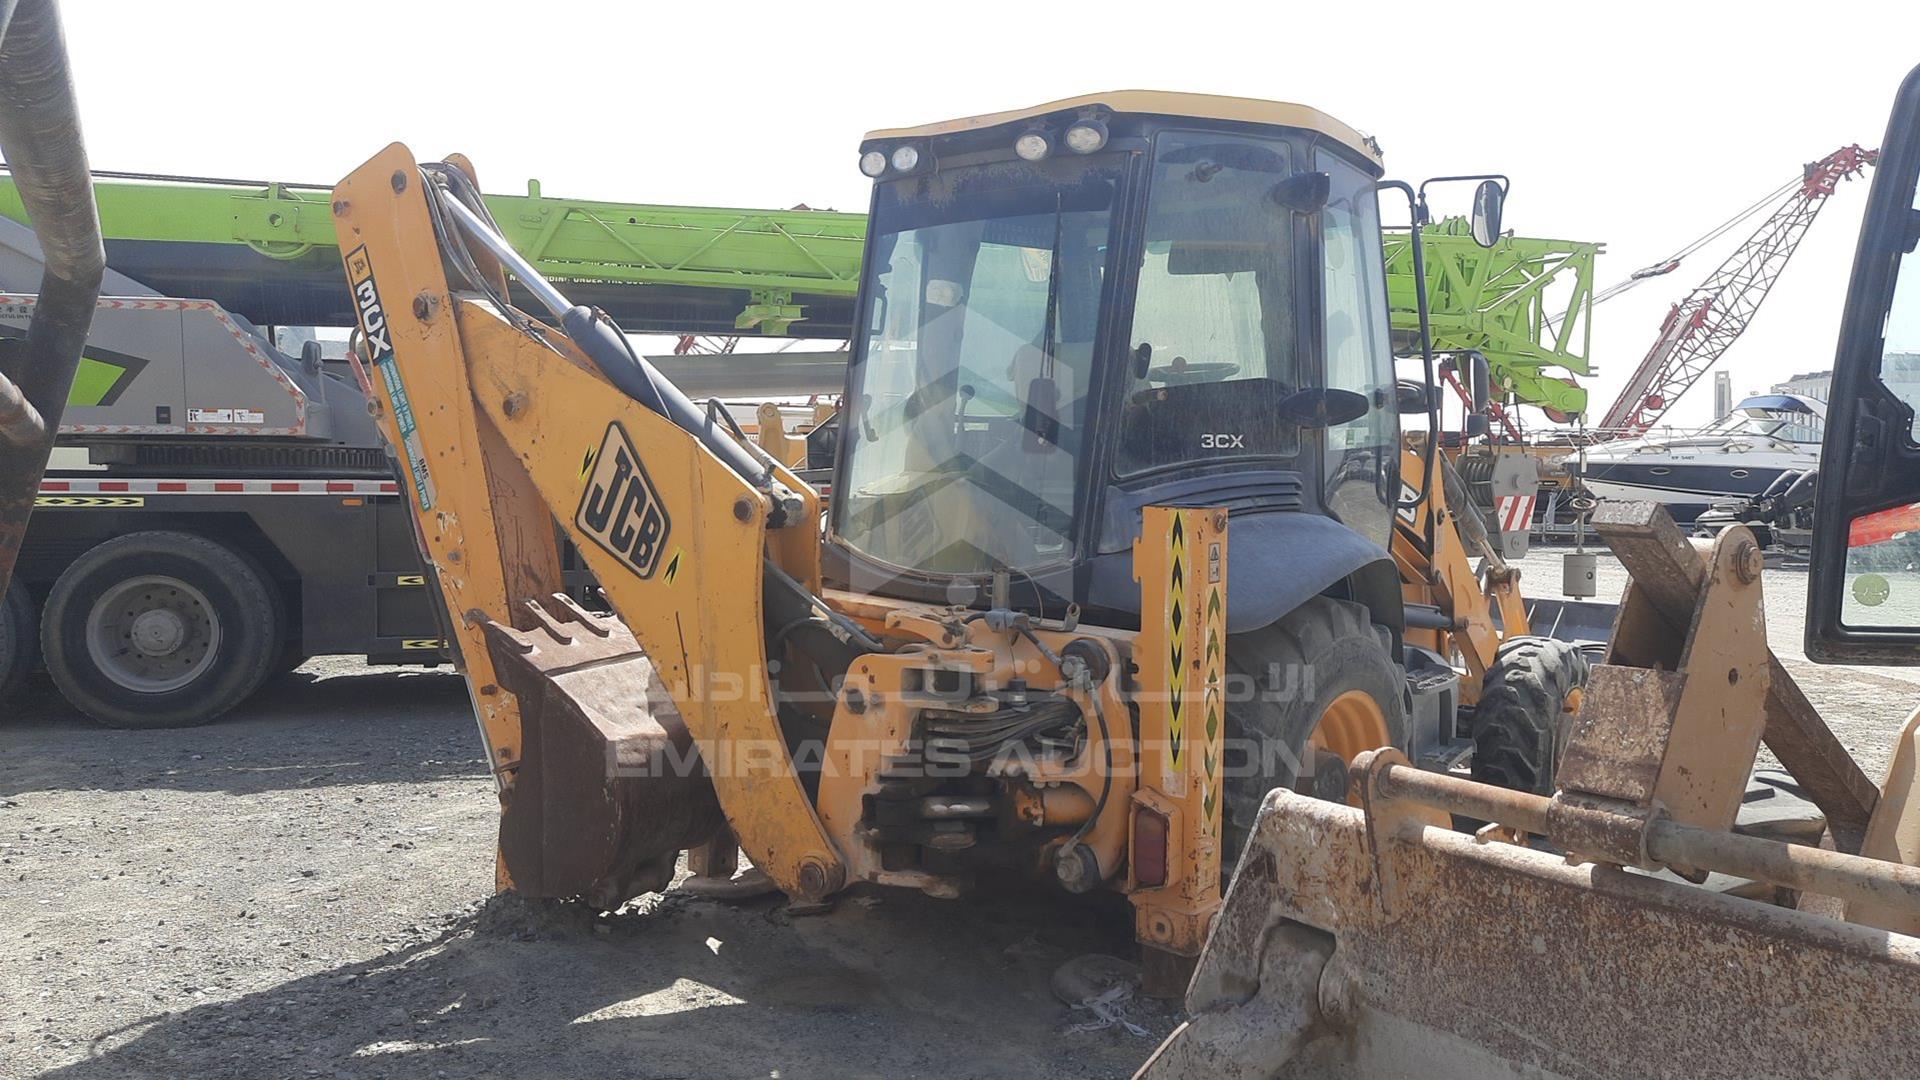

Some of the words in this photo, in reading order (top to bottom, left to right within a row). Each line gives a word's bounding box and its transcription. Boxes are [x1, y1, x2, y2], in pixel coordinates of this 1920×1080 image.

[357, 280, 391, 360] 3CX
[1201, 433, 1244, 449] 3CX
[419, 458, 429, 480] BMS
[585, 446, 662, 569] JCB
